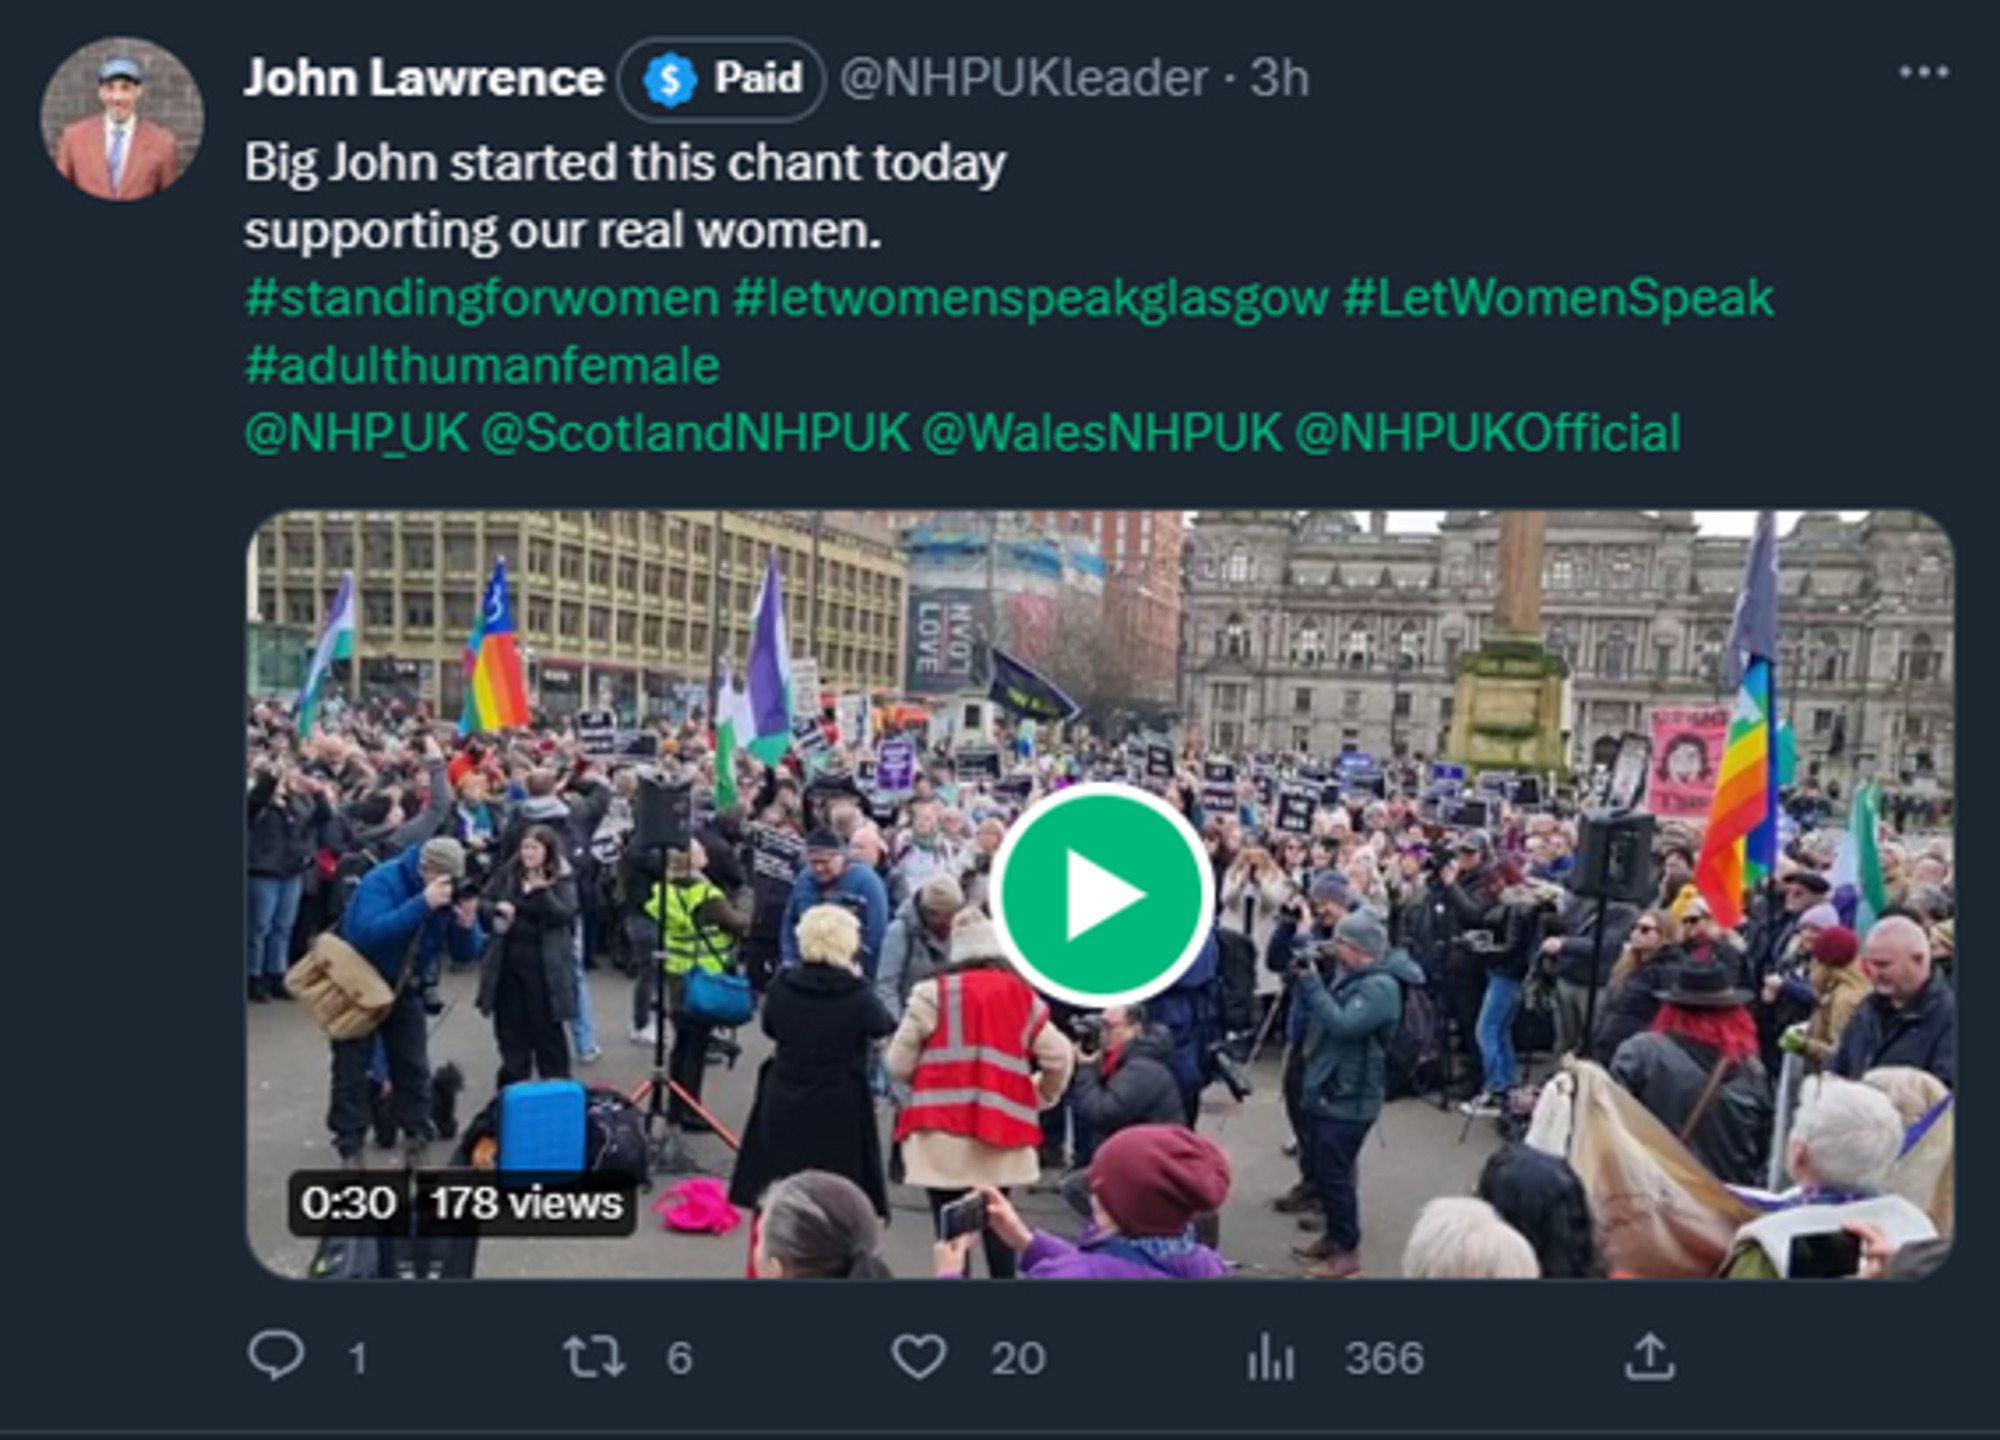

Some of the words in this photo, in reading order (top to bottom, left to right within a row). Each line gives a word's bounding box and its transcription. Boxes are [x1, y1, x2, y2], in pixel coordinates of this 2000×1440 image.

[243, 57, 358, 96] John
[370, 57, 606, 96] Lawrence
[715, 60, 803, 94] Paid
[842, 57, 1208, 99] @NHPUKleader
[1252, 57, 1308, 96] 3h
[246, 141, 319, 192] Big
[328, 141, 437, 181] John
[450, 141, 617, 181] started
[628, 141, 716, 181] this
[728, 141, 862, 181] chant
[872, 141, 1008, 192] today
[244, 209, 500, 260] supporting
[509, 219, 588, 248] our
[599, 209, 683, 248] real
[696, 219, 881, 248] women.
[246, 277, 718, 326] #standingforwomen
[734, 277, 1329, 326] #letwomenspeakglasgow
[1344, 277, 1774, 326] #LetWomenSpeak
[246, 345, 719, 385] #adulthumanfemale
[246, 412, 469, 458] @NHP_UK
[483, 412, 910, 455] @ScotlandNHPUK
[923, 412, 1282, 455] @WalesNHPUK
[1296, 412, 1680, 455] @NHPUKOfficial
[916, 602, 941, 674] LOVE
[349, 1342, 364, 1374] 1
[668, 1342, 691, 1374] 6
[994, 1342, 1044, 1374] 20
[1347, 1342, 1423, 1374] 366
